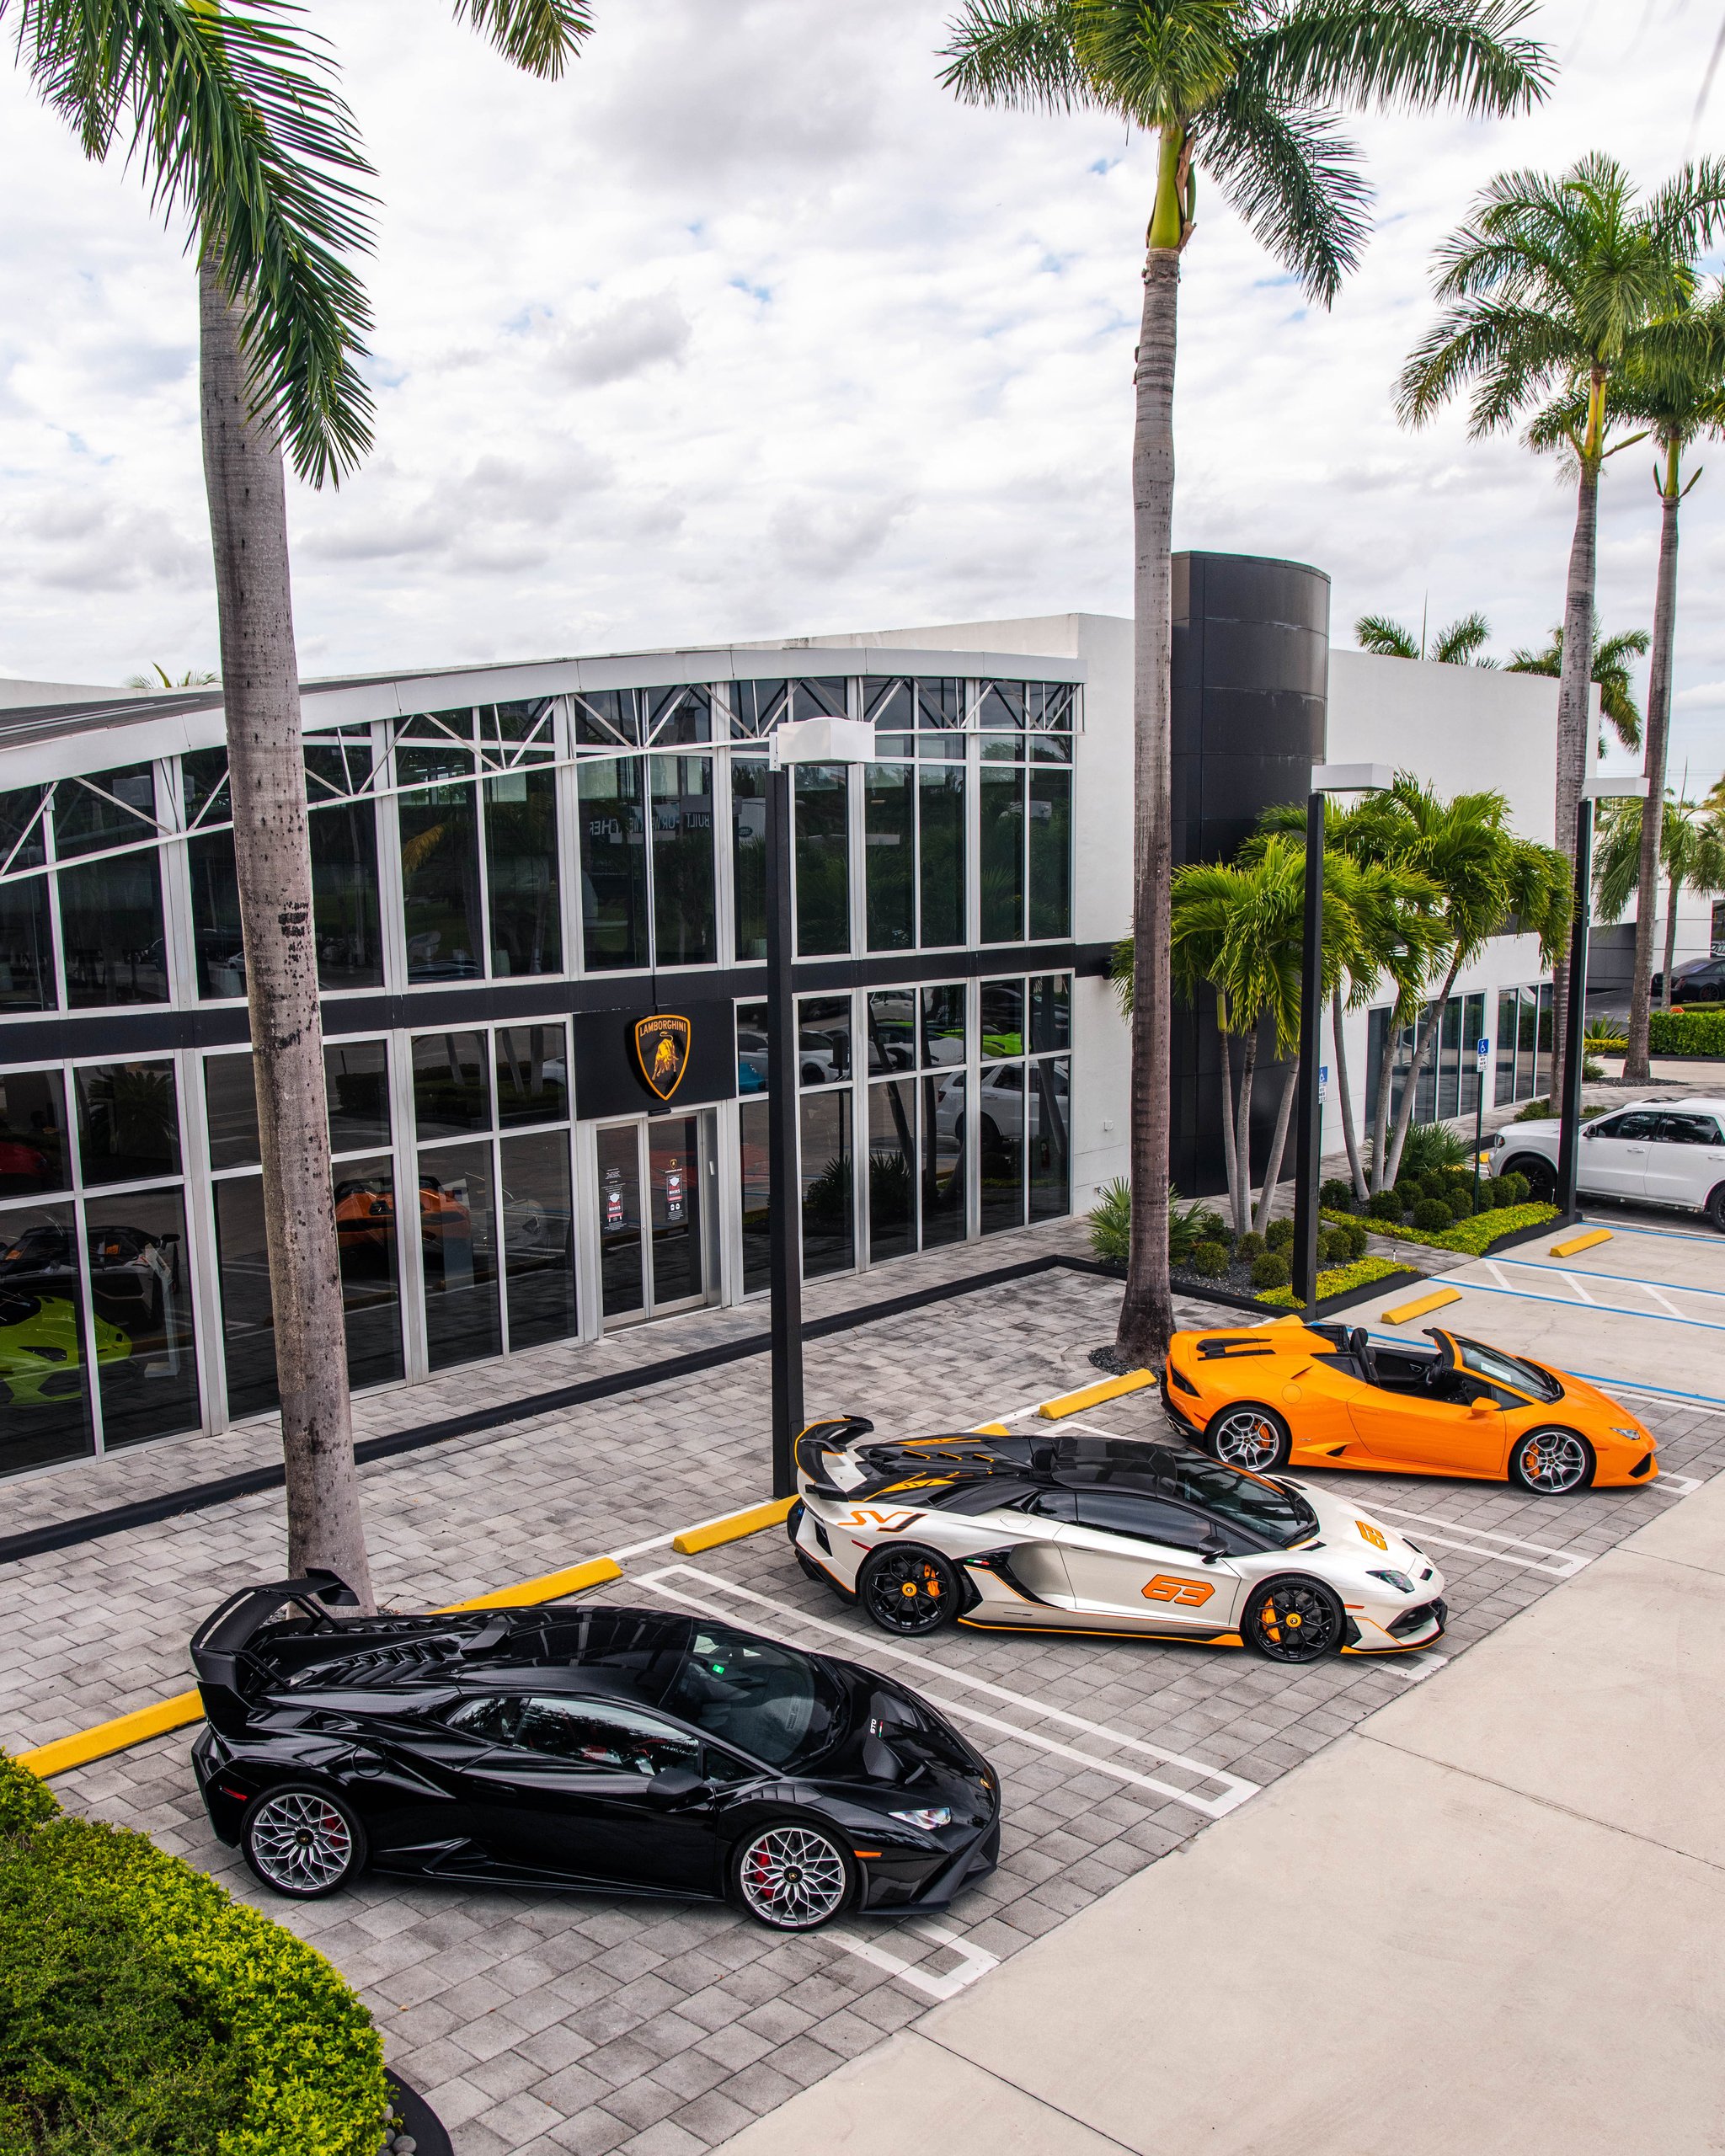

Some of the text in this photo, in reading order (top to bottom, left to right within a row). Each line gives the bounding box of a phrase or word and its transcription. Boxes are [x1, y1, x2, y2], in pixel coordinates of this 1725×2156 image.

[640, 1020, 686, 1037] LAMBORGHINI
[837, 1510, 928, 1533] SVJ
[1141, 1573, 1215, 1607] 63
